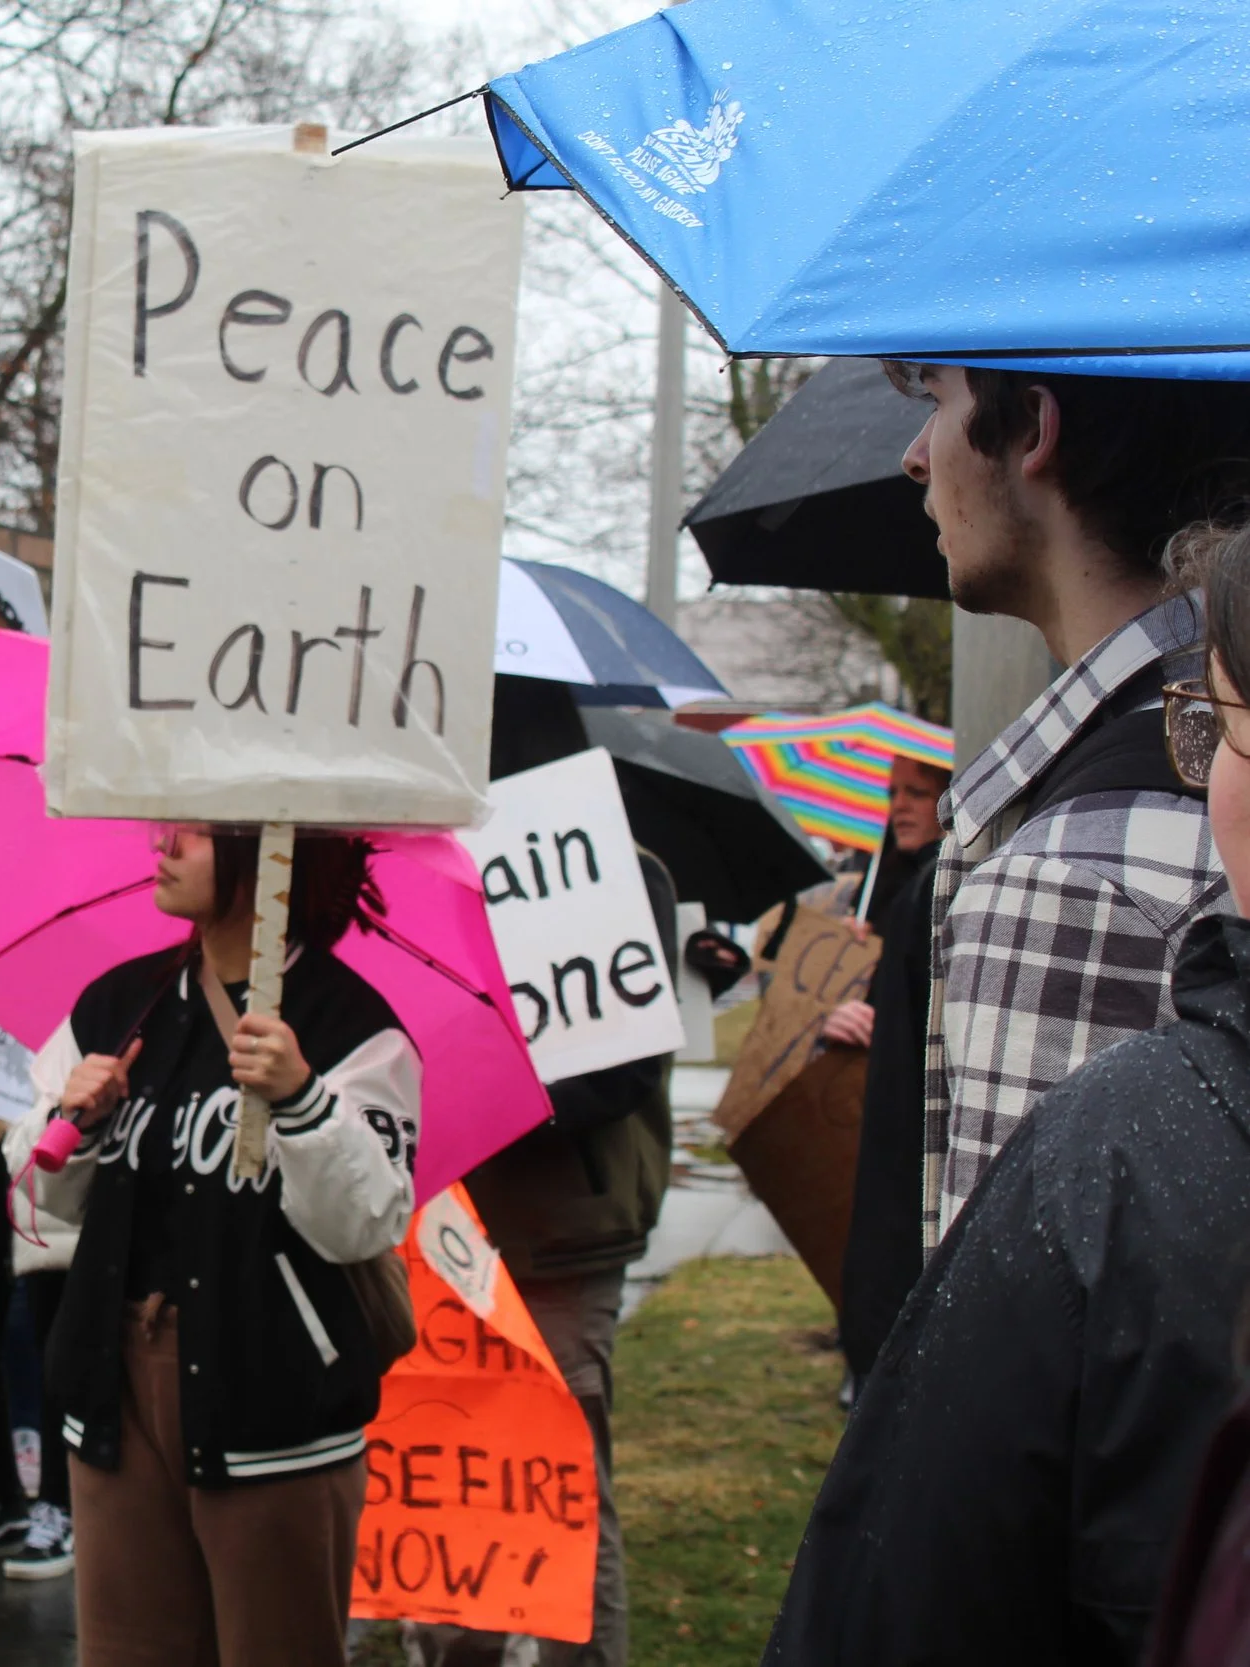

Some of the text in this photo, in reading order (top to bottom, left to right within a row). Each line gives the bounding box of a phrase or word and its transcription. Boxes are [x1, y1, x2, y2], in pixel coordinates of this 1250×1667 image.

[626, 146, 663, 175] PLEASE
[636, 187, 661, 203] MY
[653, 196, 704, 228] GARDEN
[131, 209, 495, 402] Peace
[239, 453, 365, 532] on
[127, 568, 446, 737] Earth
[482, 827, 602, 906] ain
